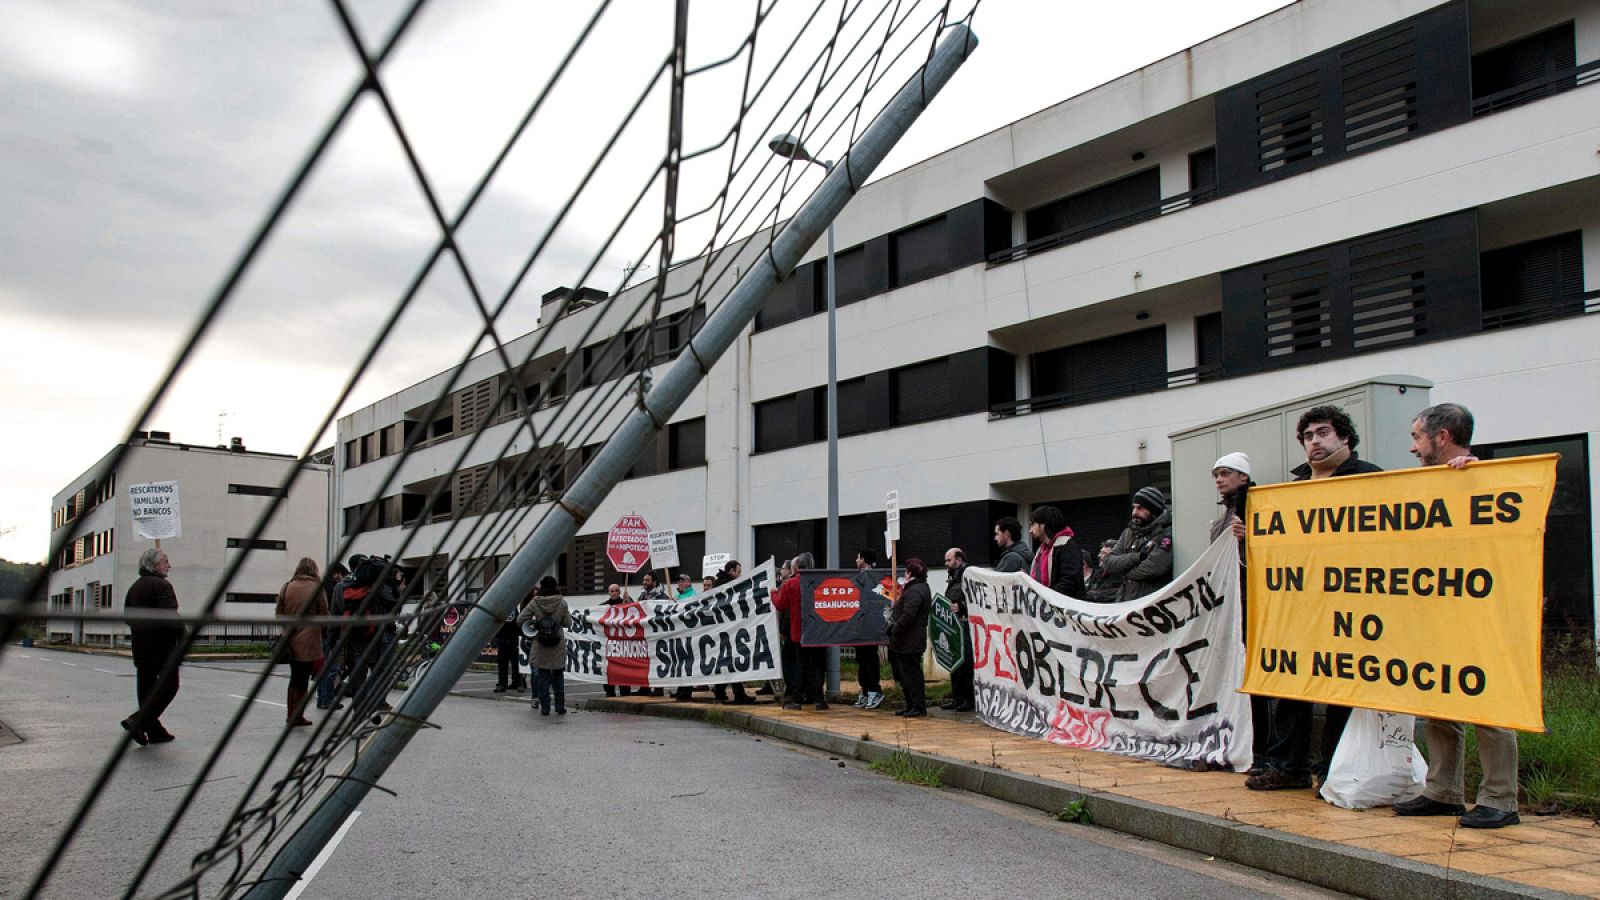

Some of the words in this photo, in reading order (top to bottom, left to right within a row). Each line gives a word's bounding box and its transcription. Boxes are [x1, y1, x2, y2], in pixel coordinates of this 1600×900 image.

[130, 485, 173, 495] RESCATEMOS
[134, 496, 163, 505] FAMILIAS
[164, 496, 170, 504] Y
[143, 507, 172, 516] BANCOS
[1253, 510, 1286, 537] LA
[1297, 498, 1452, 534] VIVIENDA
[1470, 491, 1523, 525] ES
[822, 587, 854, 596] STOP
[1266, 567, 1304, 592] UN
[1324, 567, 1493, 598] DERECHO
[679, 570, 771, 628] GENTE
[814, 600, 860, 609] DESAHUCIOS
[993, 584, 1009, 614] LA
[935, 602, 953, 626] PAH
[1333, 611, 1384, 641] NO
[607, 639, 648, 658] DESAHUCIOS
[655, 636, 695, 678] SIN
[699, 624, 775, 676] CASA
[1260, 648, 1297, 675] UN
[1312, 651, 1486, 696] NEGOCIO
